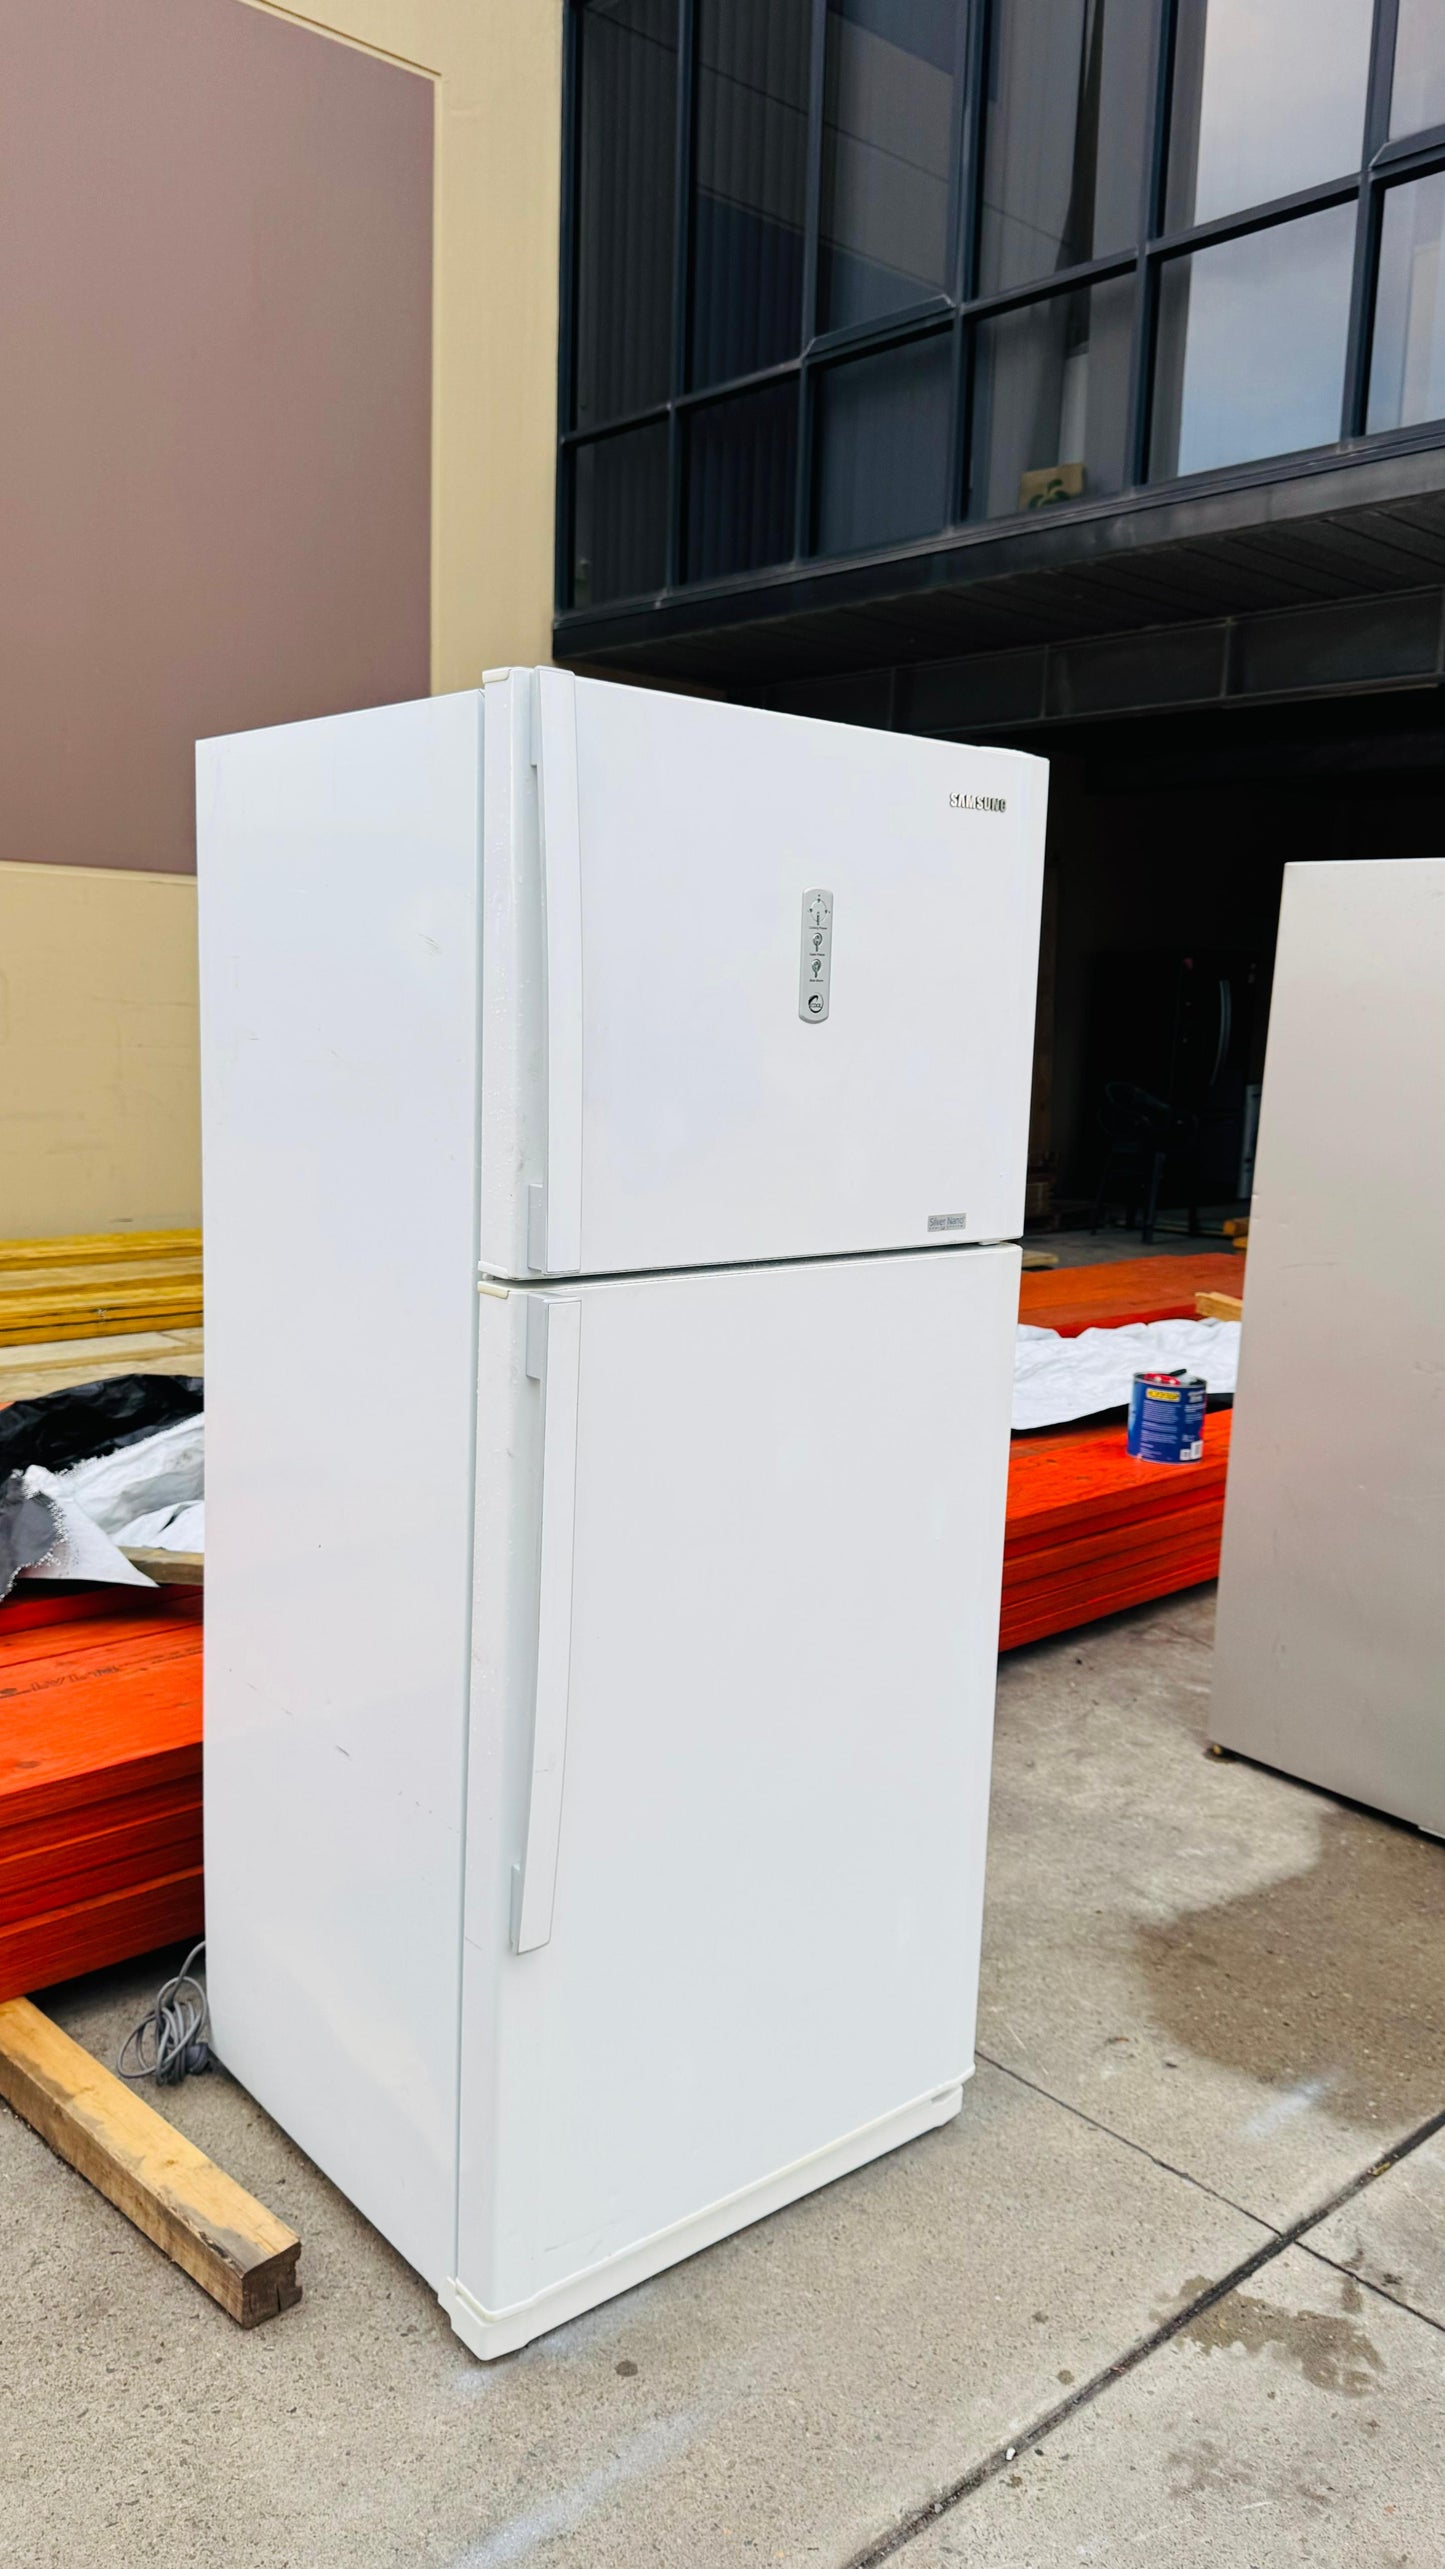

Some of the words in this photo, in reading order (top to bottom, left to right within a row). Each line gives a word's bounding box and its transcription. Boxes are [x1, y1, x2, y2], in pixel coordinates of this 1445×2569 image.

[950, 792, 1006, 813] SAMSUNG
[929, 1217, 946, 1227] Silver
[947, 1216, 964, 1225] Nano
